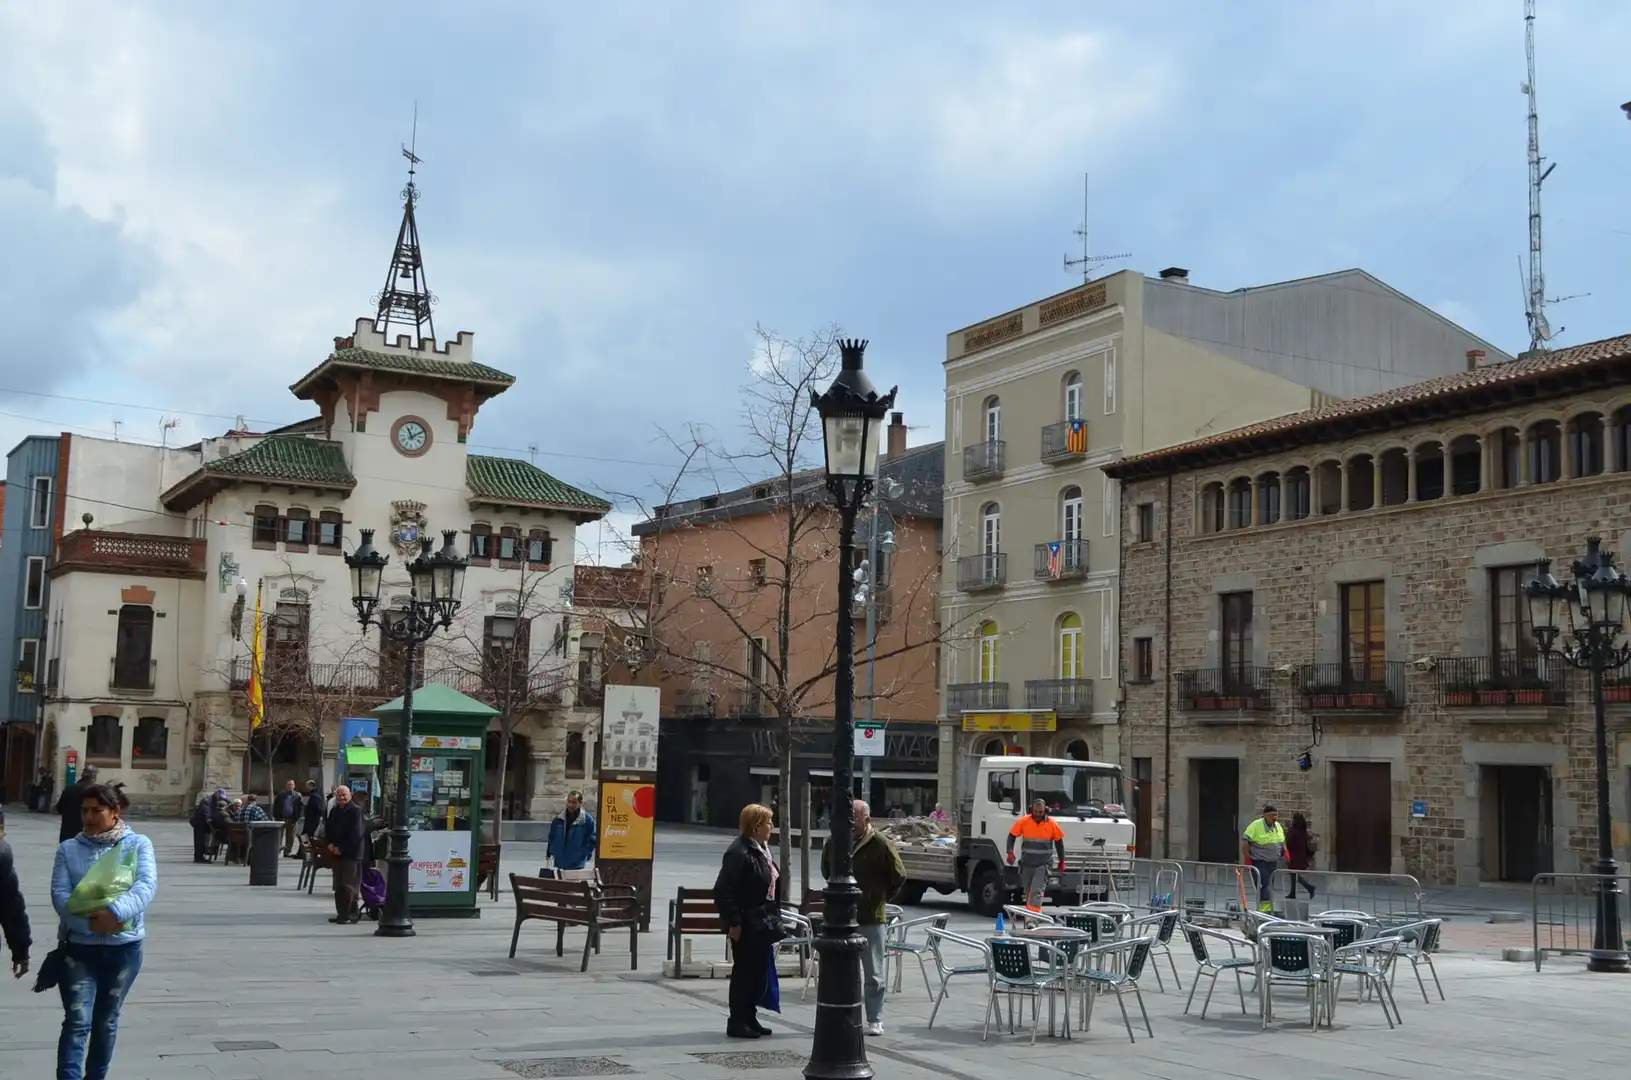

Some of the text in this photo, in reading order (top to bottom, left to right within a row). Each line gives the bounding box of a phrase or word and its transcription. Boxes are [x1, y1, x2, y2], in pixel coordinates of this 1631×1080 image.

[606, 796, 616, 805] GI
[605, 805, 618, 814] TA
[610, 814, 629, 823] NES
